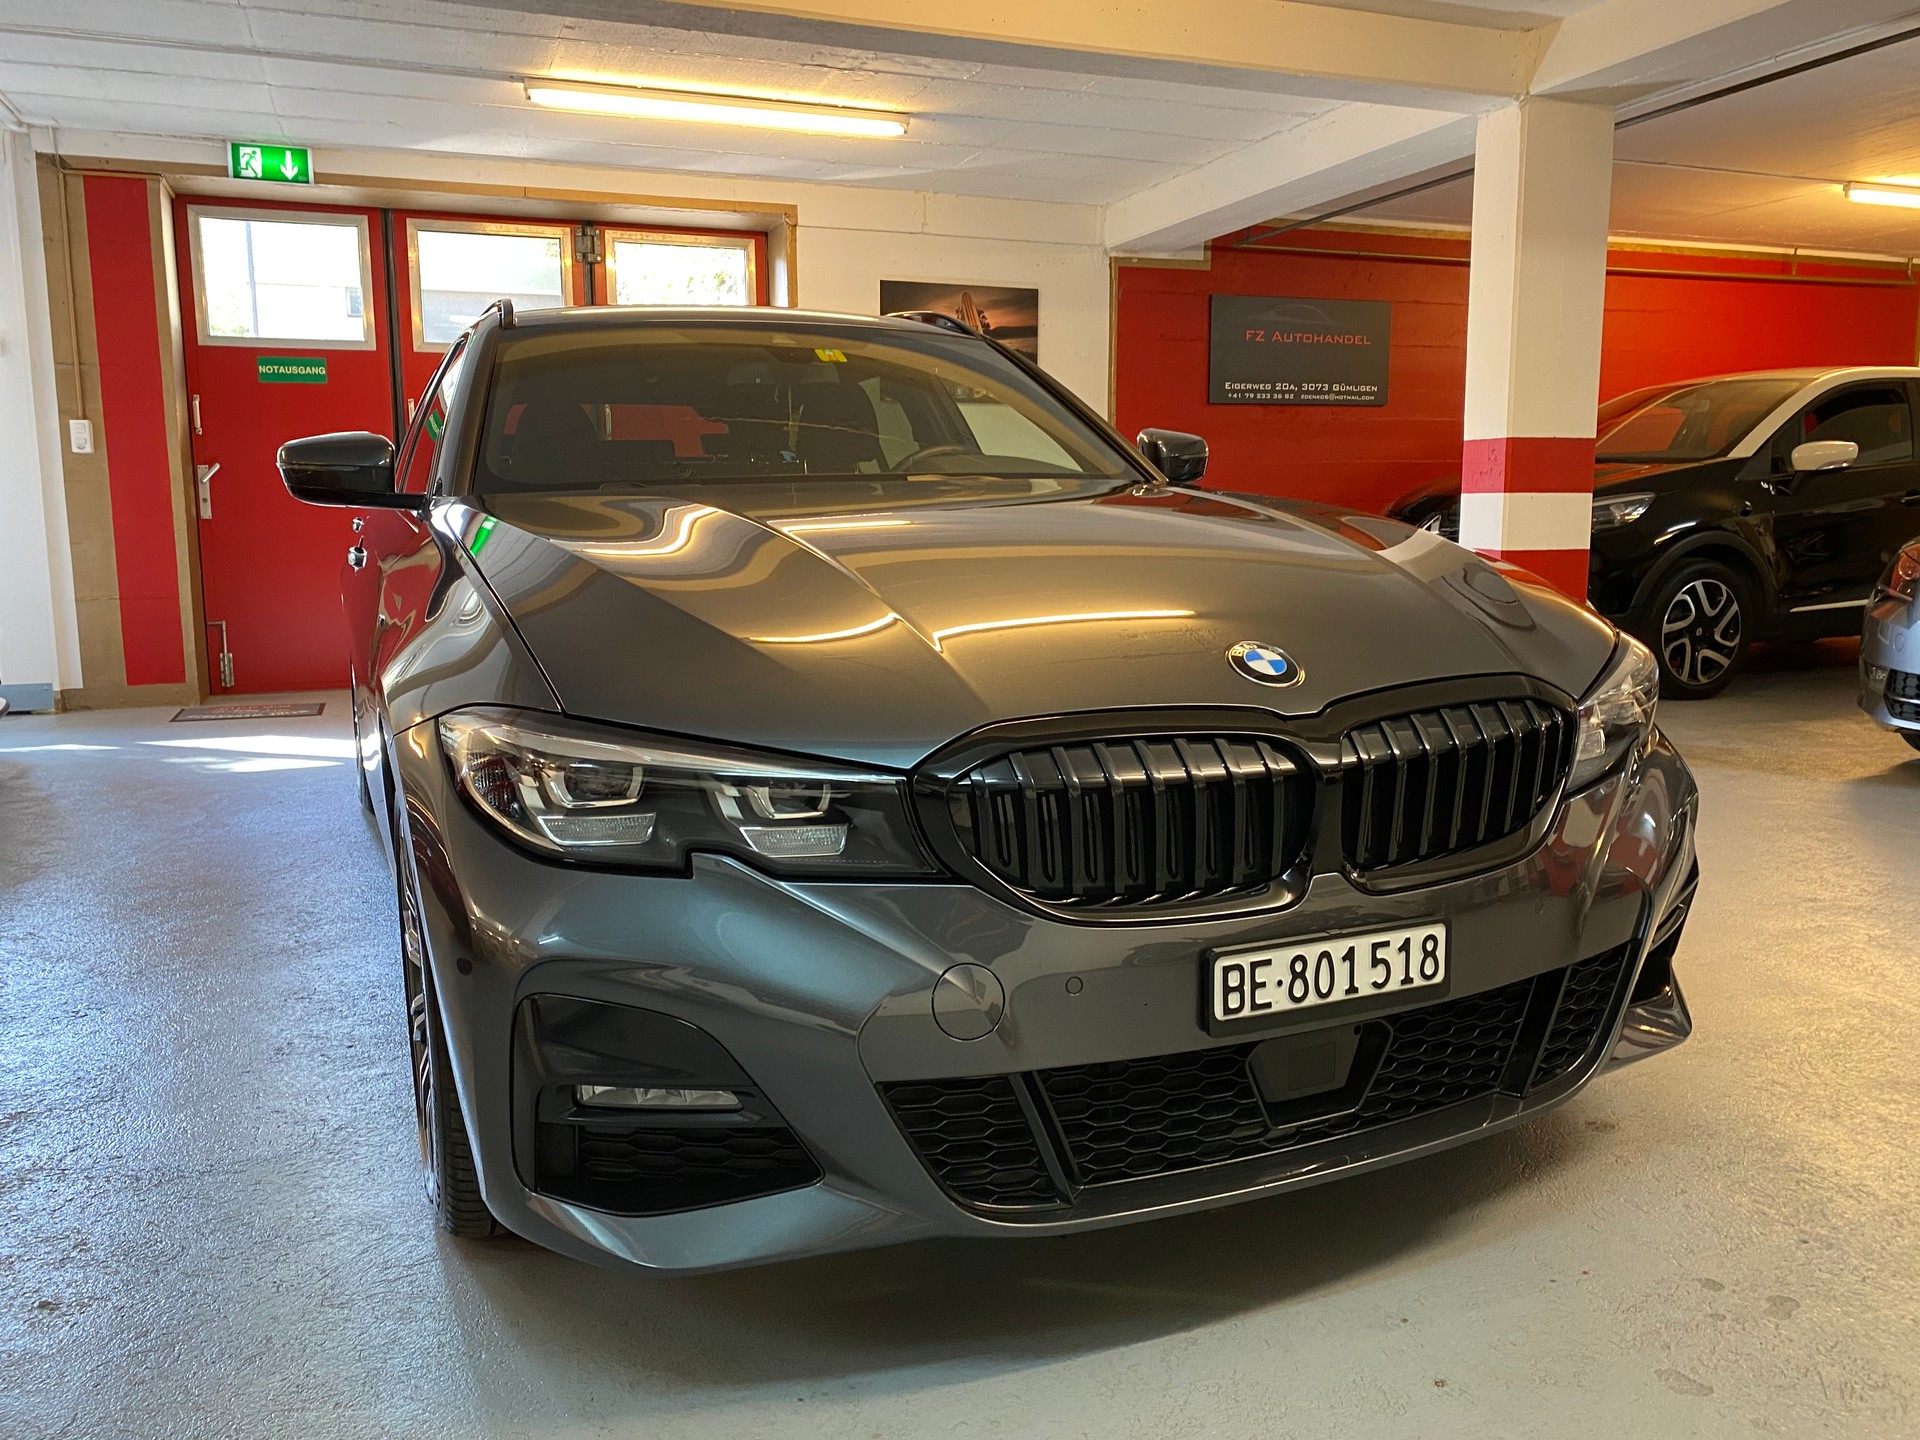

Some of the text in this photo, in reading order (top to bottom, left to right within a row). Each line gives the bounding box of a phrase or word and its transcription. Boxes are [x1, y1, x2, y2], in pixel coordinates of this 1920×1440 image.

[1245, 330, 1372, 345] FZ AUTOHANDEL
[258, 365, 326, 375] NOTAUSGANG
[1301, 383, 1329, 391] 3073
